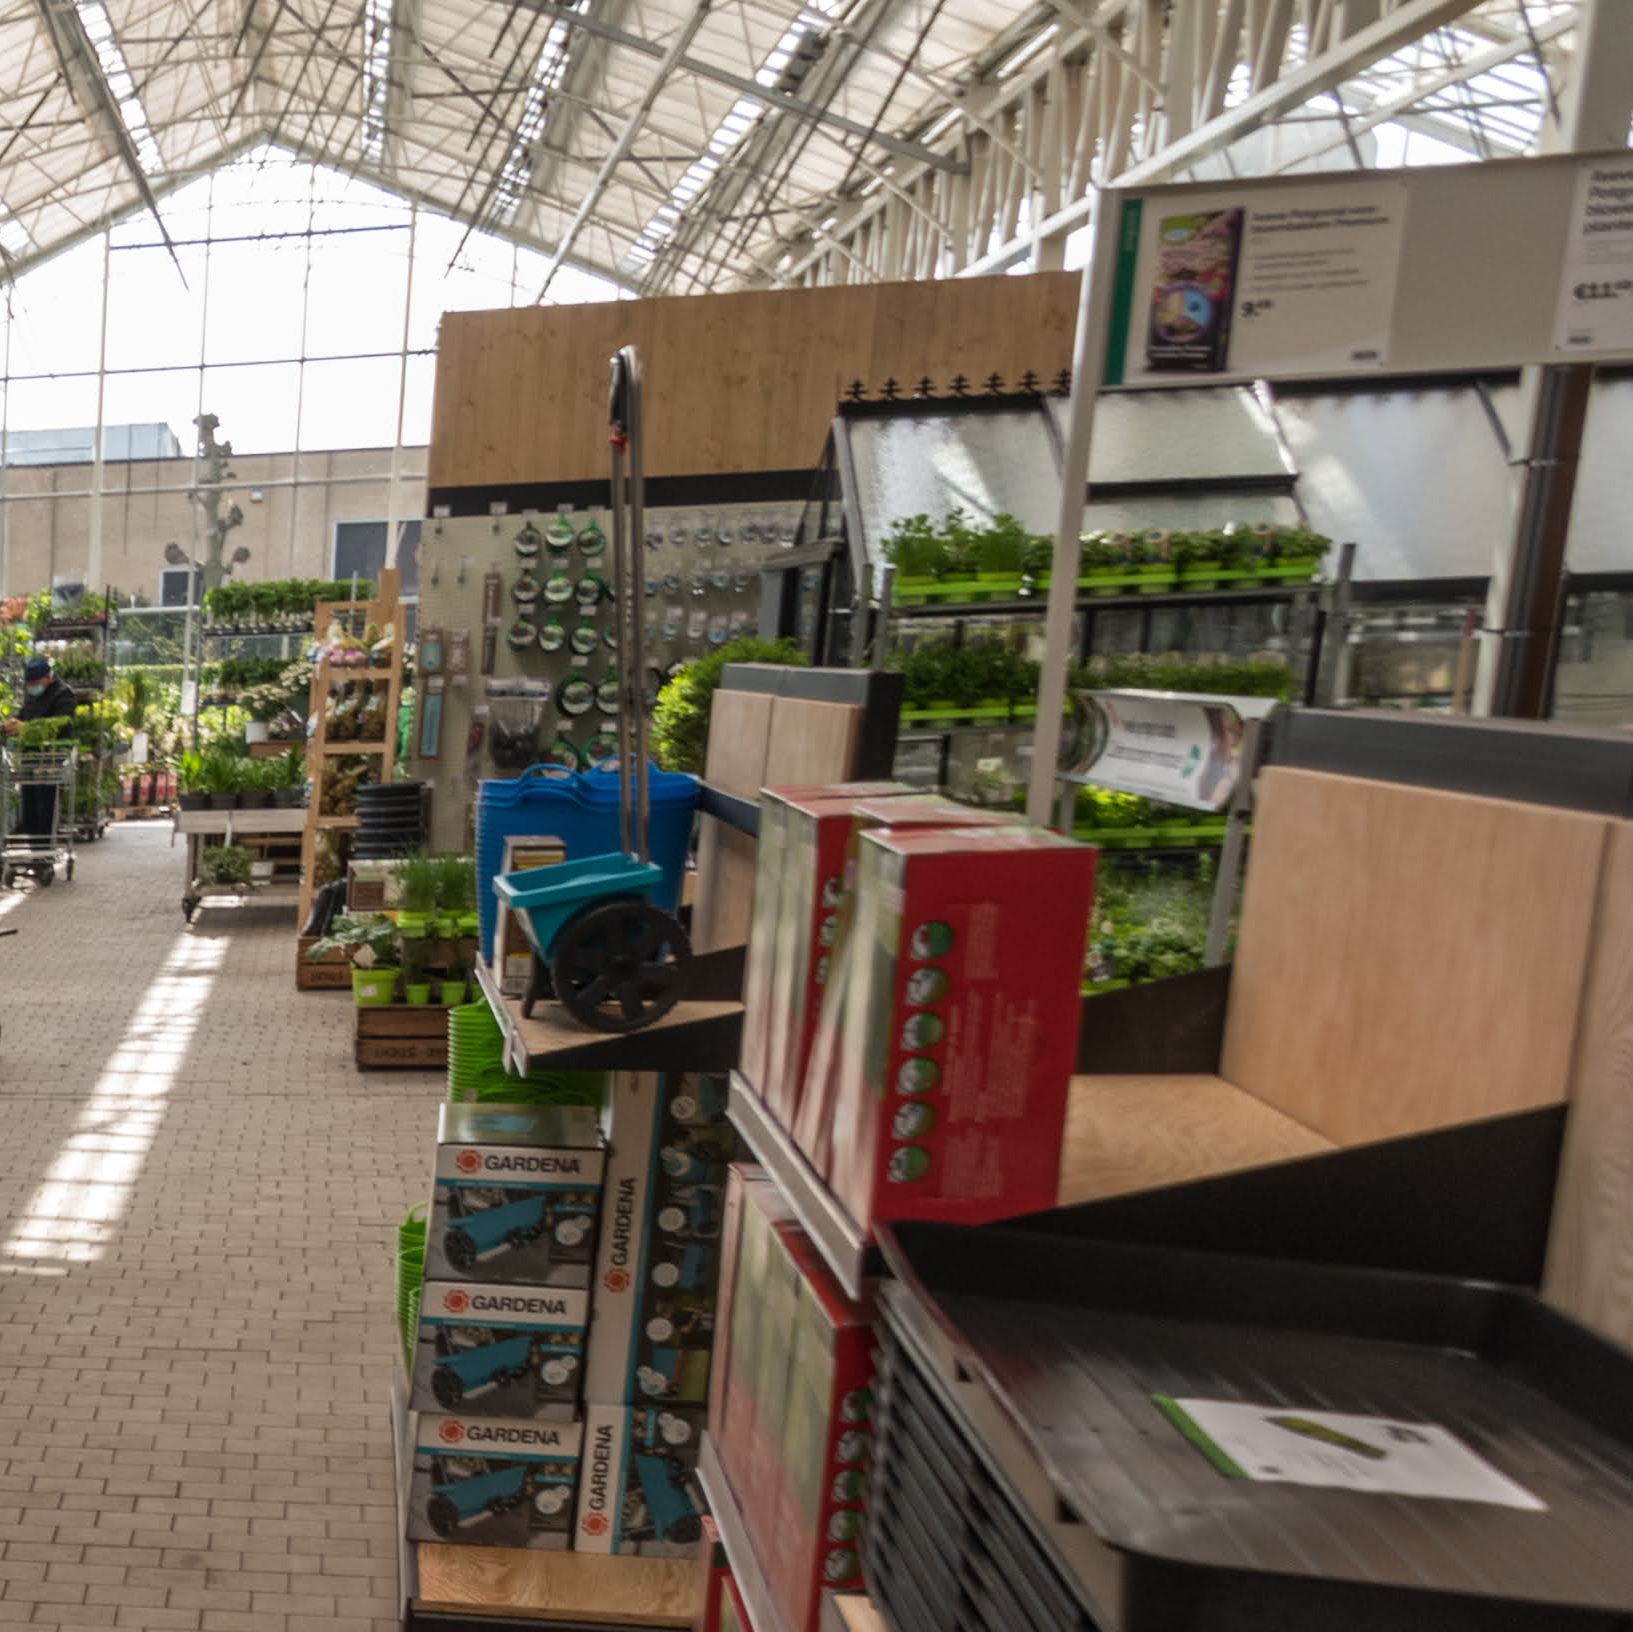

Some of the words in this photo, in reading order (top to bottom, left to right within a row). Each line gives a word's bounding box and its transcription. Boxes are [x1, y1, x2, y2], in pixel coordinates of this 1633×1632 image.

[484, 1154, 582, 1174] GARDENA
[611, 1177, 636, 1267] GARDENA
[471, 1291, 568, 1315] GARDENA
[466, 1424, 562, 1447] GARDENA
[590, 1423, 614, 1513] GARDENA
